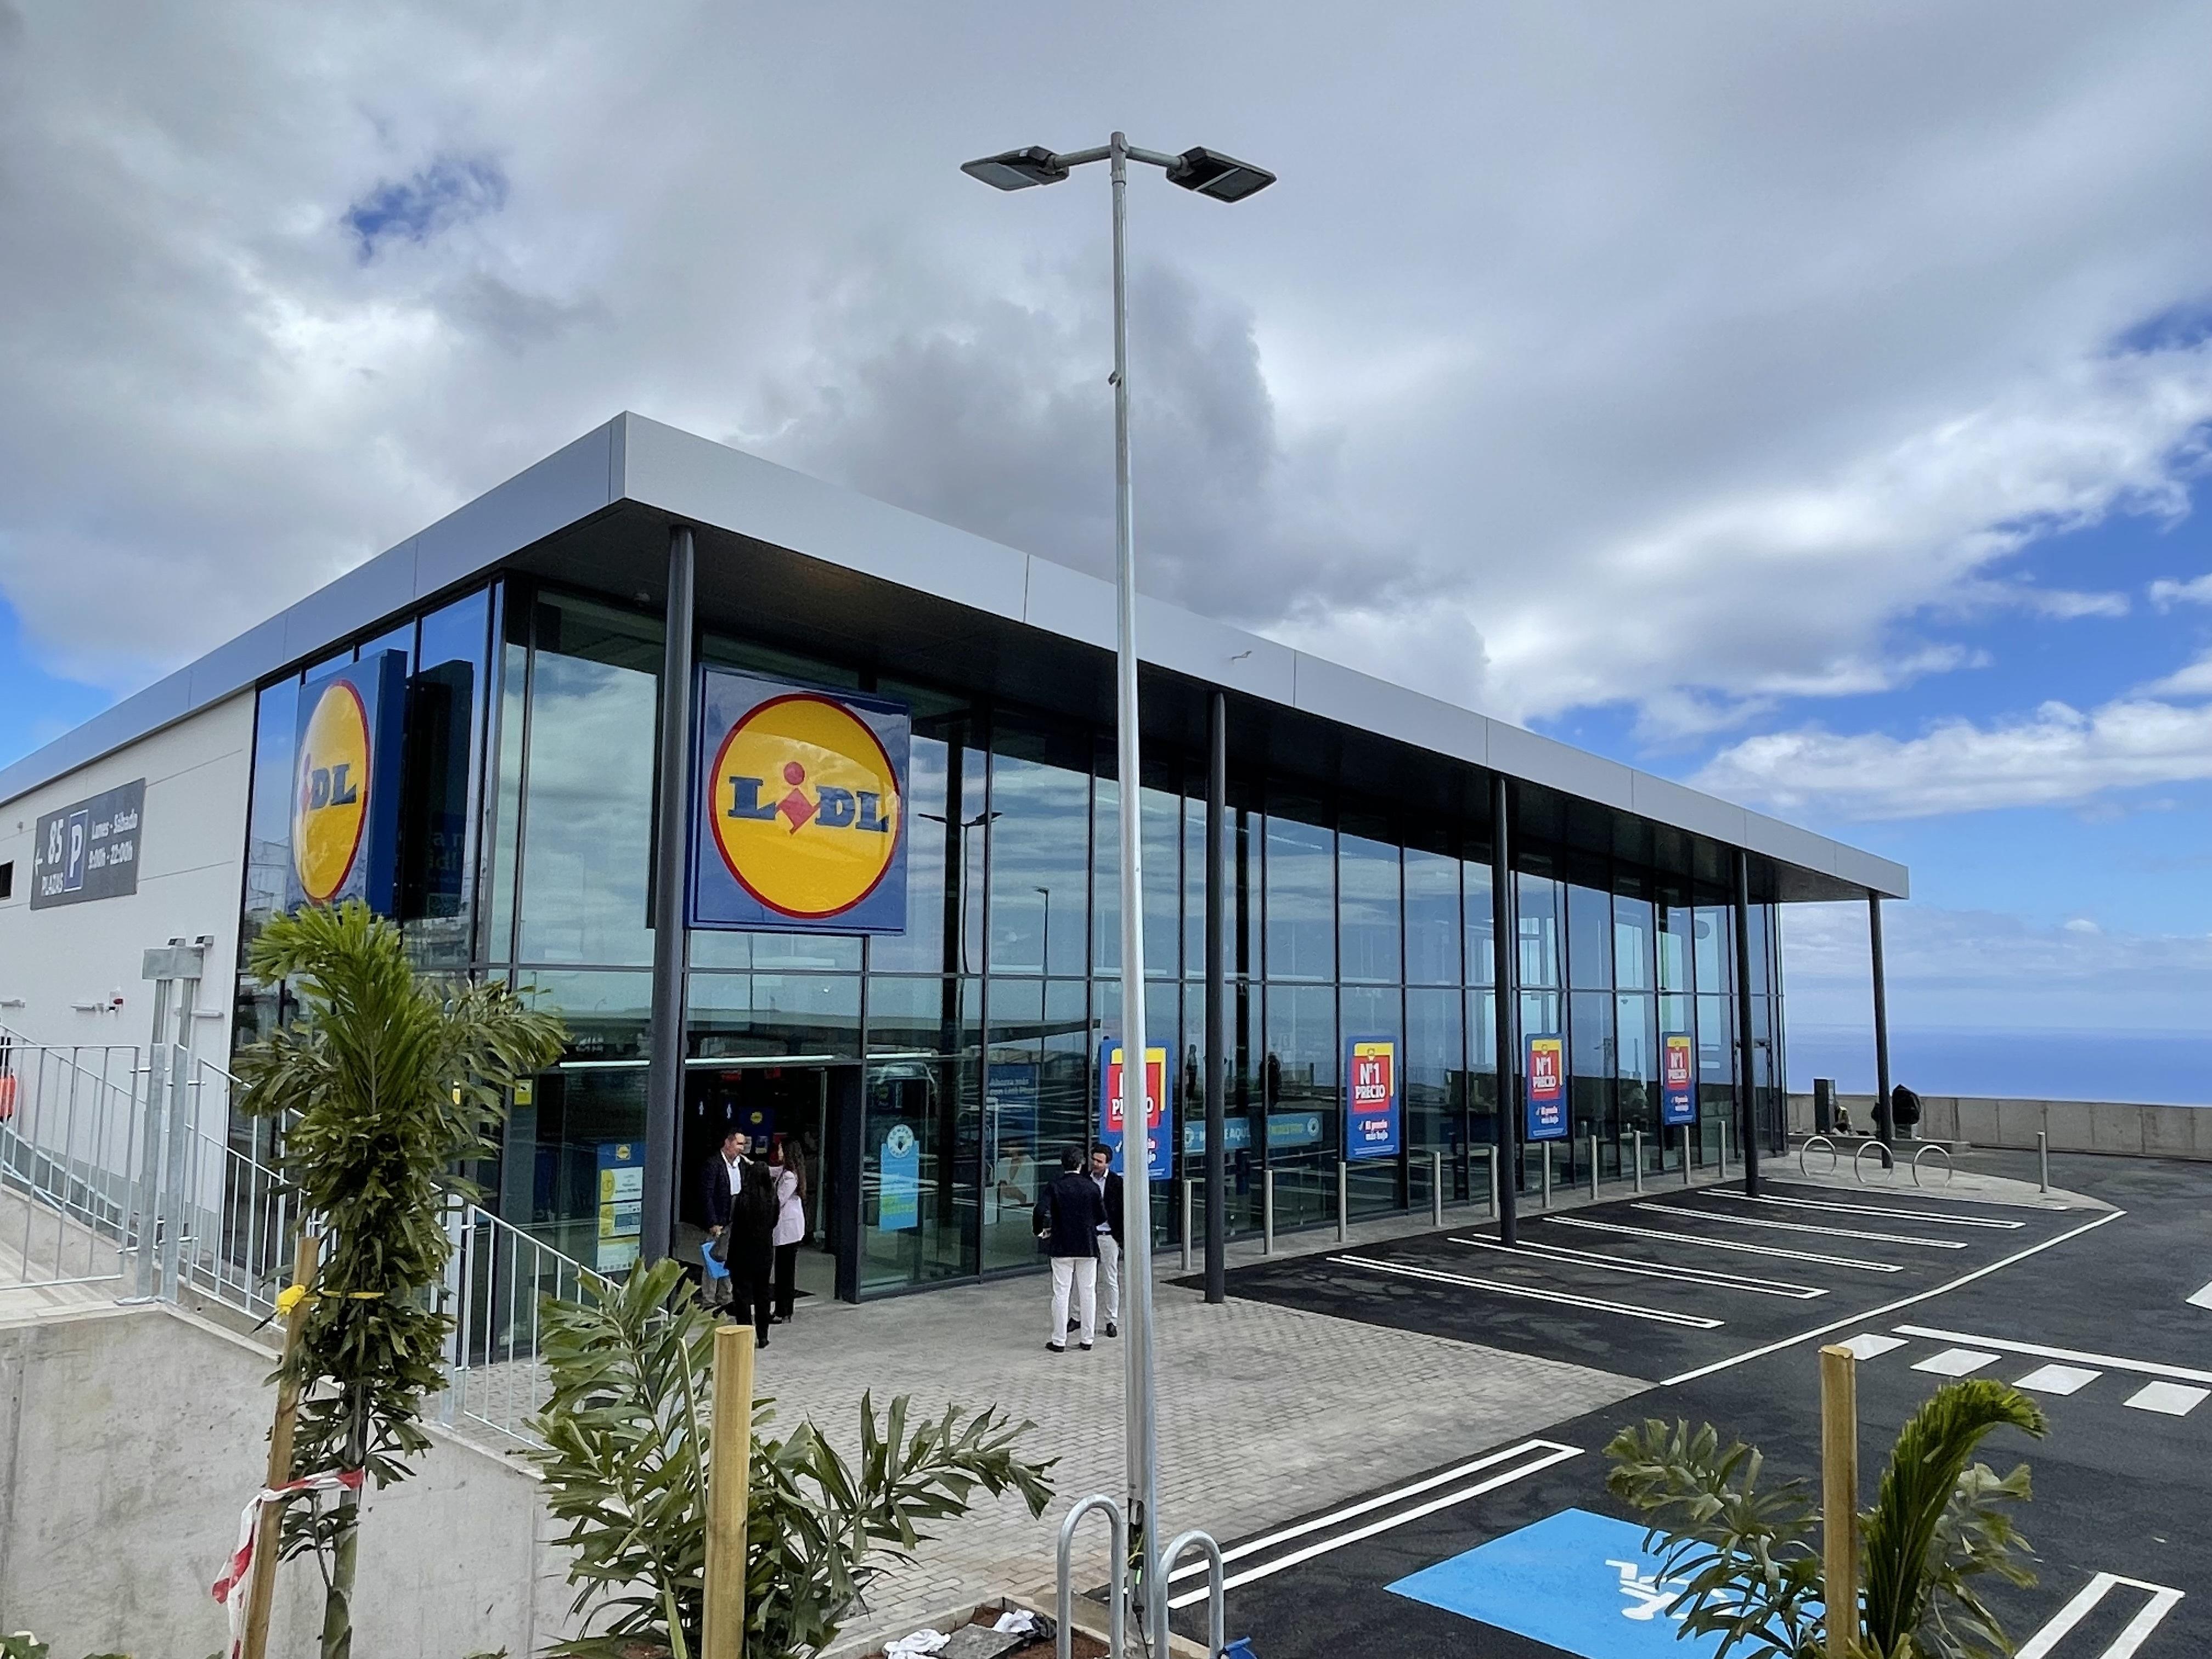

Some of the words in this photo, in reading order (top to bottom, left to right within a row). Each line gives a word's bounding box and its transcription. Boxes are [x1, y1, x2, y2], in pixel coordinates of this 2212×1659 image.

[47, 819, 64, 864] 85
[69, 823, 82, 878] P
[1355, 1084, 1386, 1099] PRECIO
